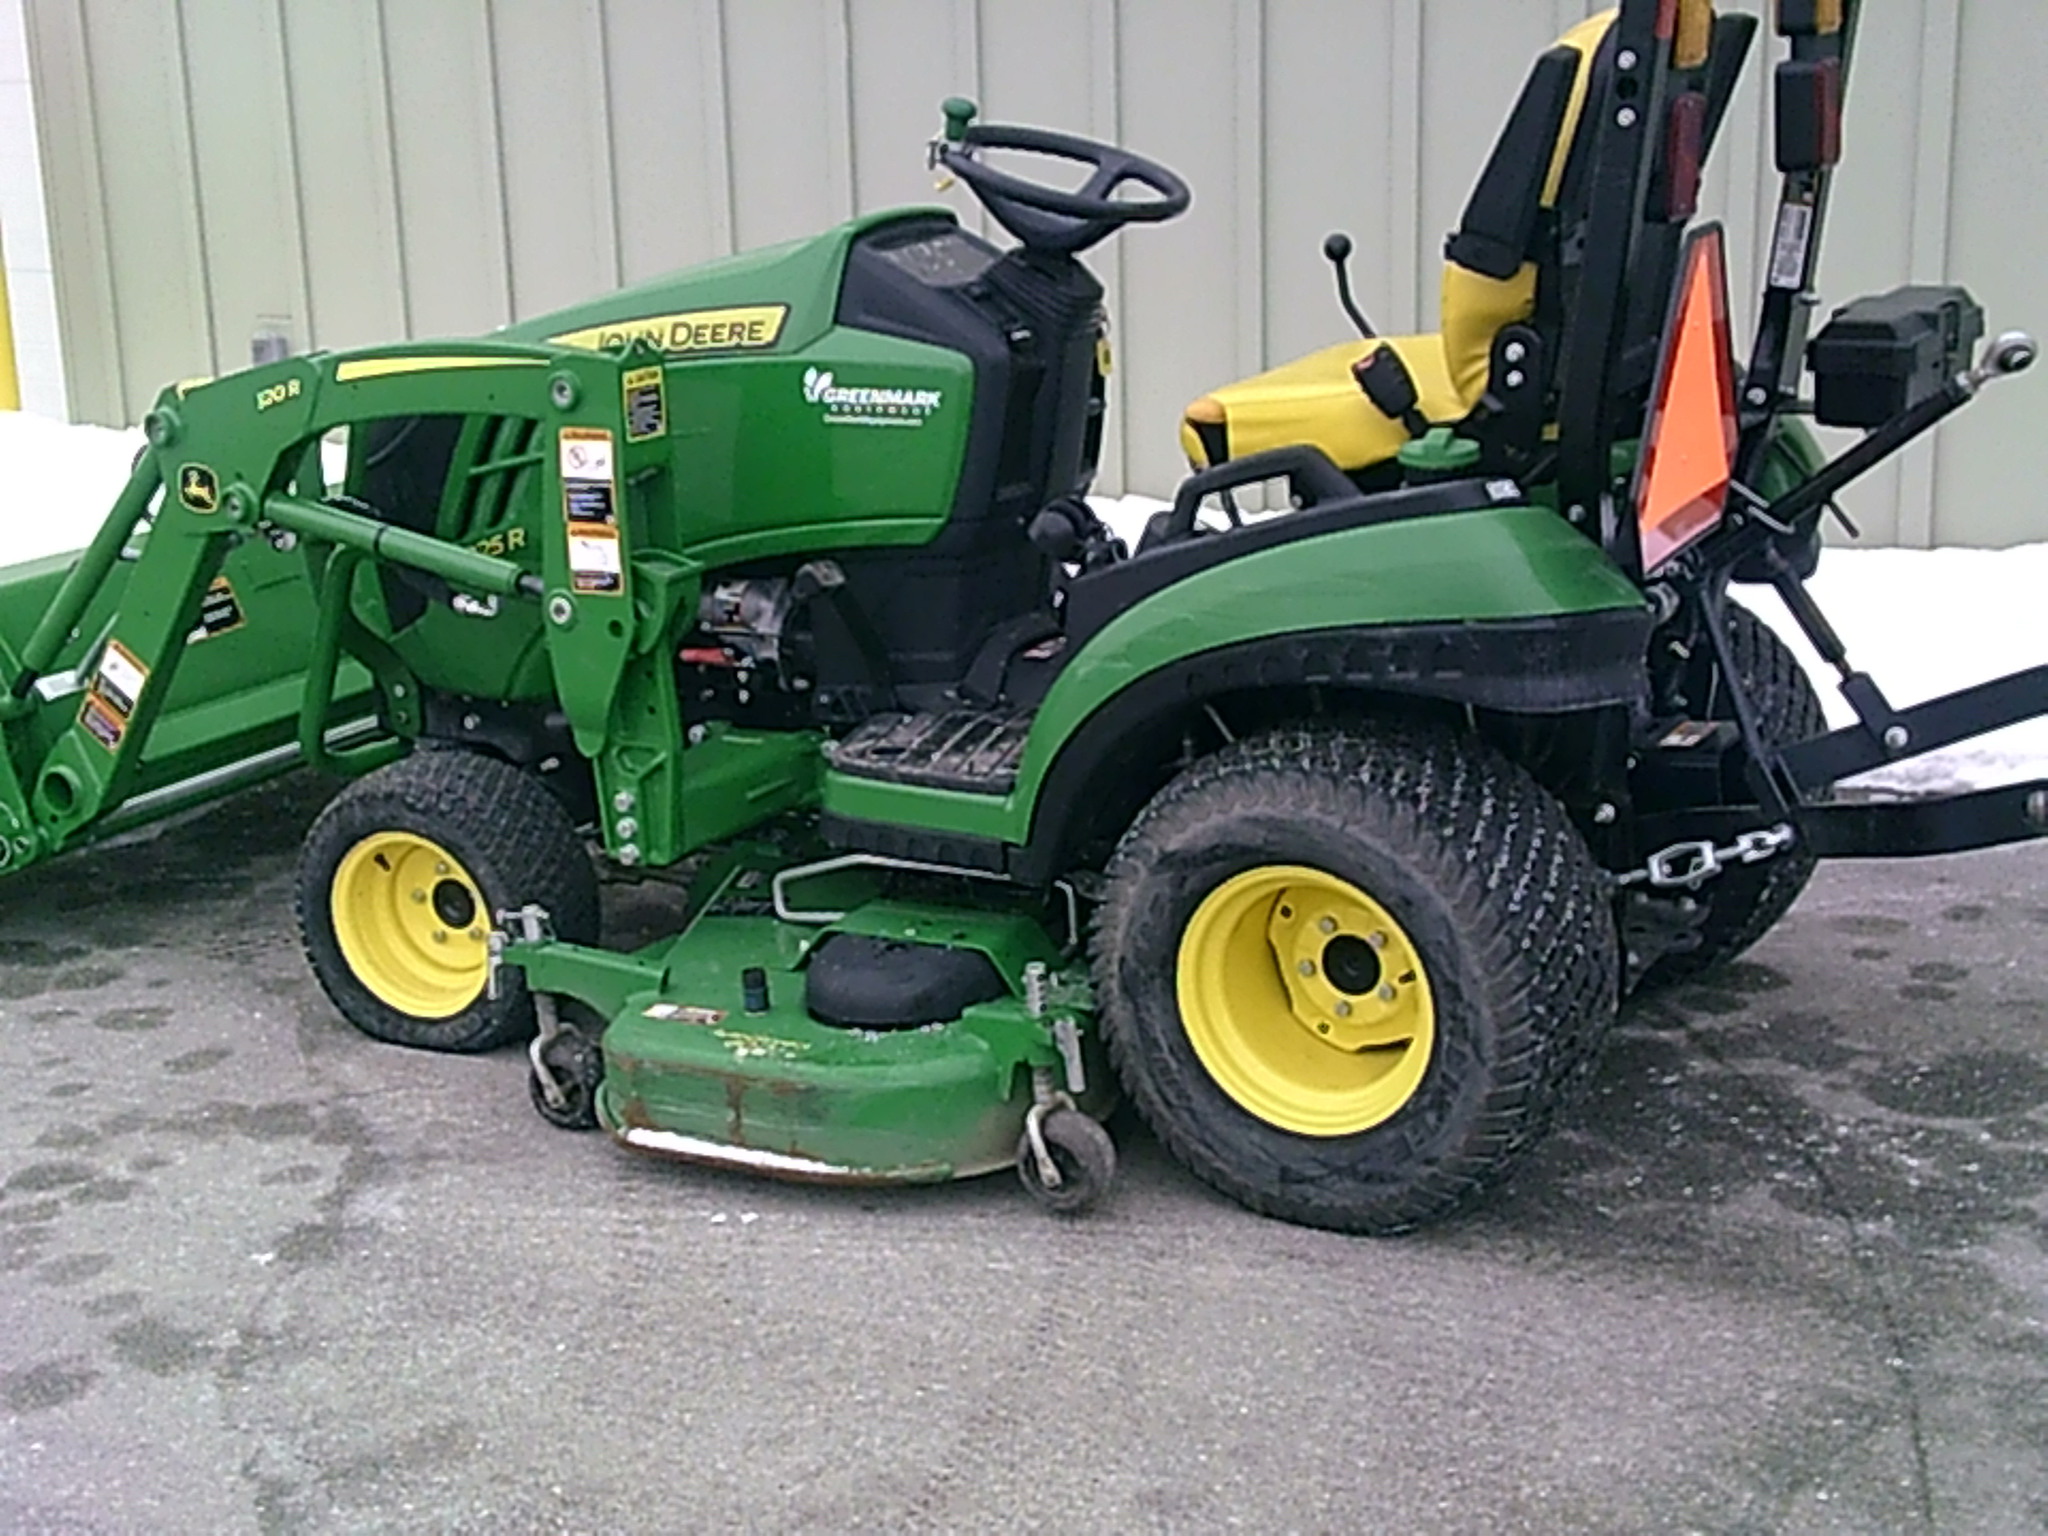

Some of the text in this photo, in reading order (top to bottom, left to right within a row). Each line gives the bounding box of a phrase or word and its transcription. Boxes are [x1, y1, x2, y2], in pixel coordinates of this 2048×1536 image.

[670, 321, 766, 347] DEERE
[288, 379, 301, 397] R
[822, 386, 942, 408] GREENMARK
[468, 528, 526, 556] 25 R
